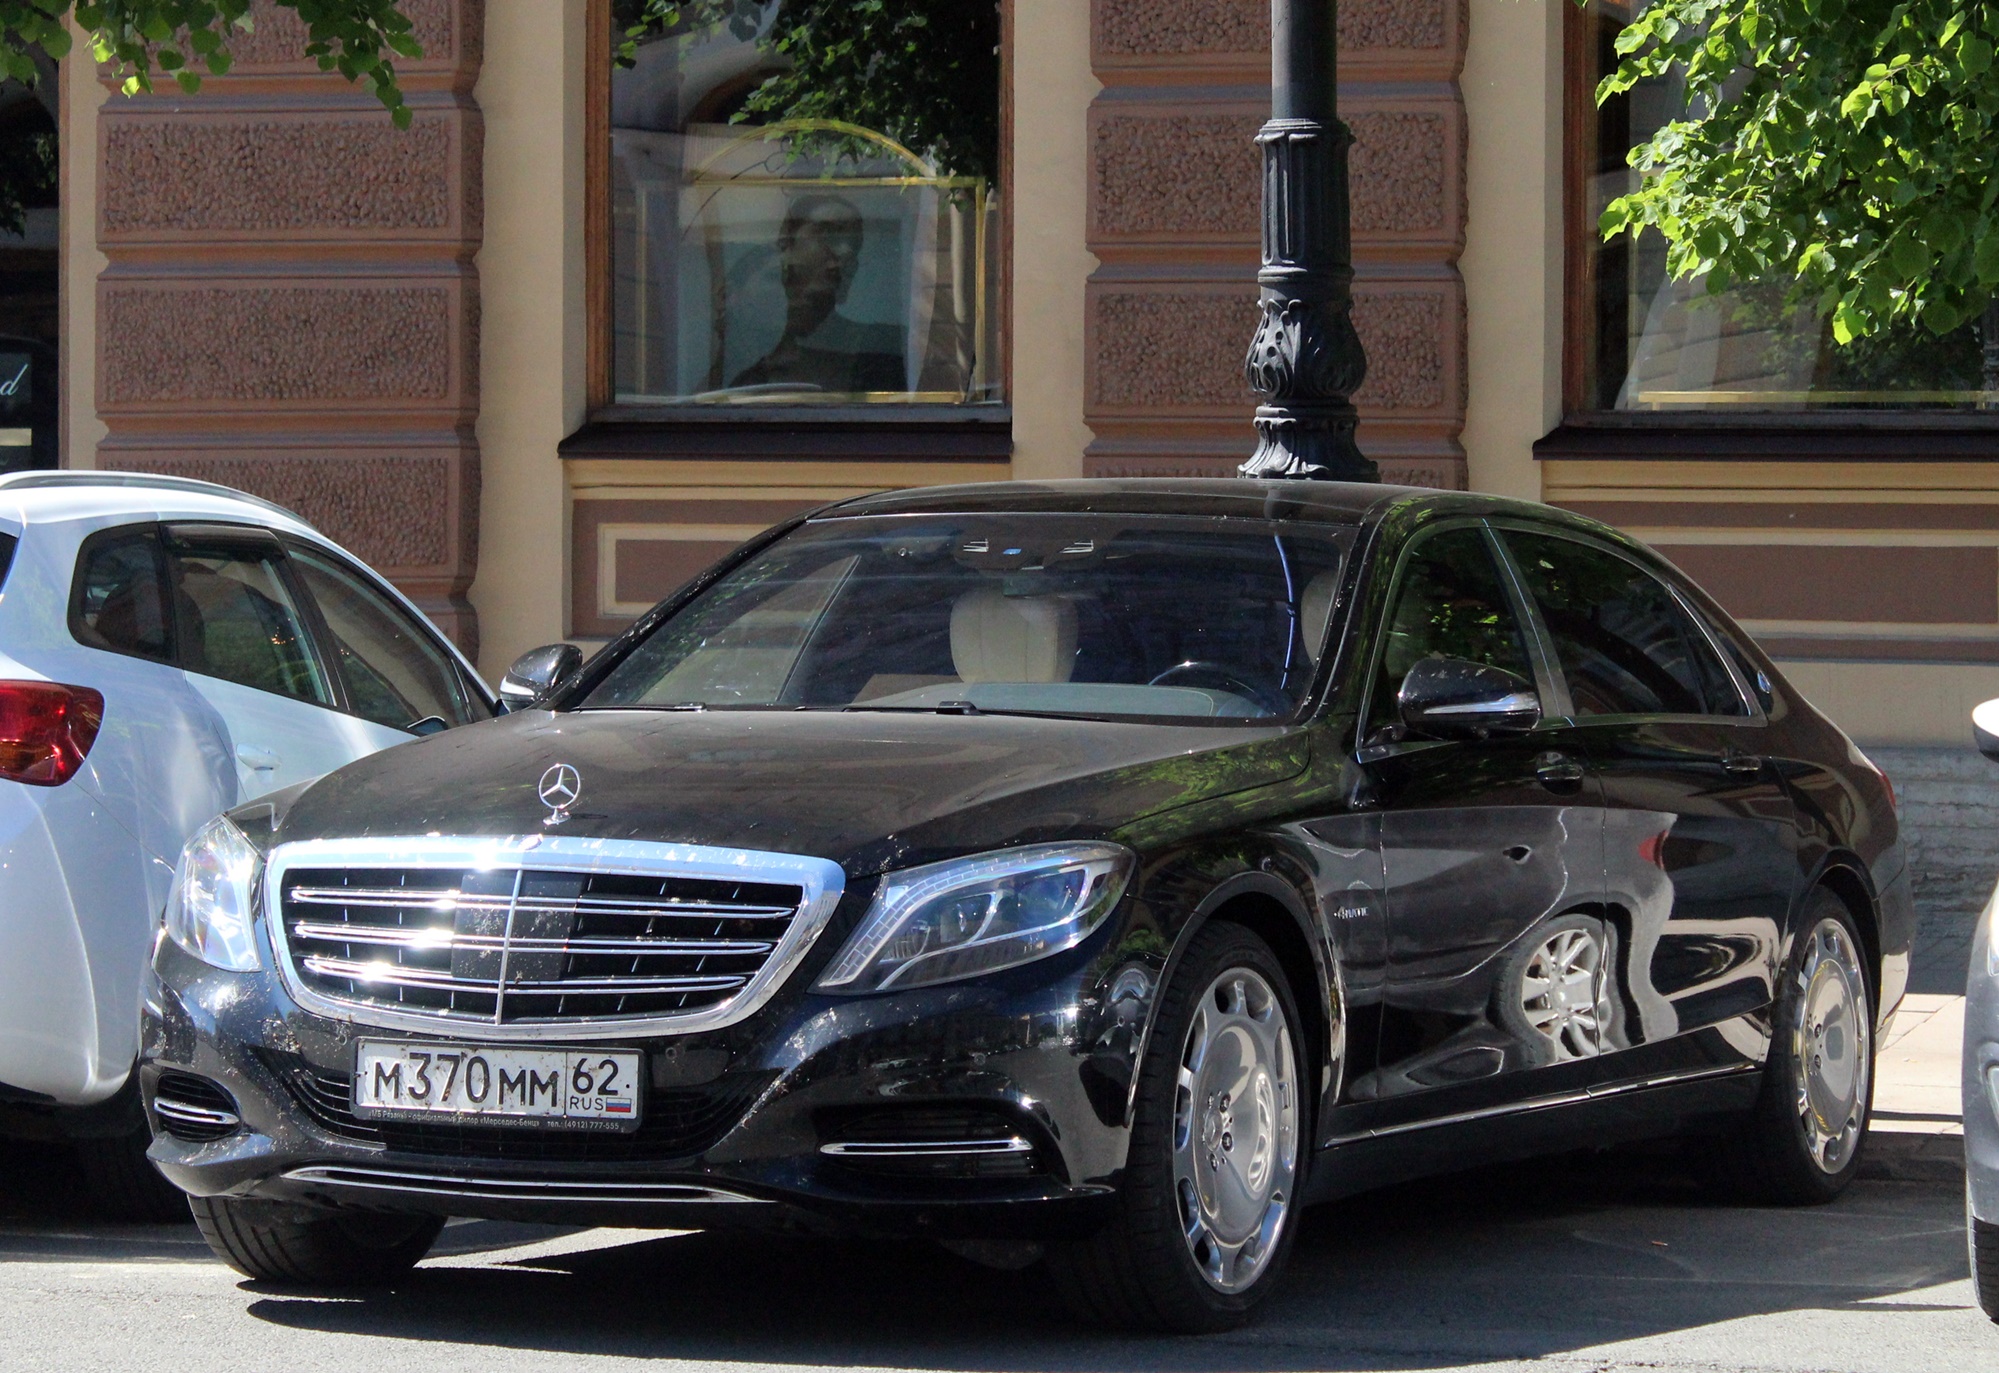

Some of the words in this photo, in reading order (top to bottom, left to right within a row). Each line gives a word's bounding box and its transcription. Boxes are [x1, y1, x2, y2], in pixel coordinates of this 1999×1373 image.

[572, 1057, 619, 1096] 62
[569, 1097, 604, 1112] RUS
[564, 1120, 588, 1129] (4912)
[589, 1121, 620, 1130] 777-555
